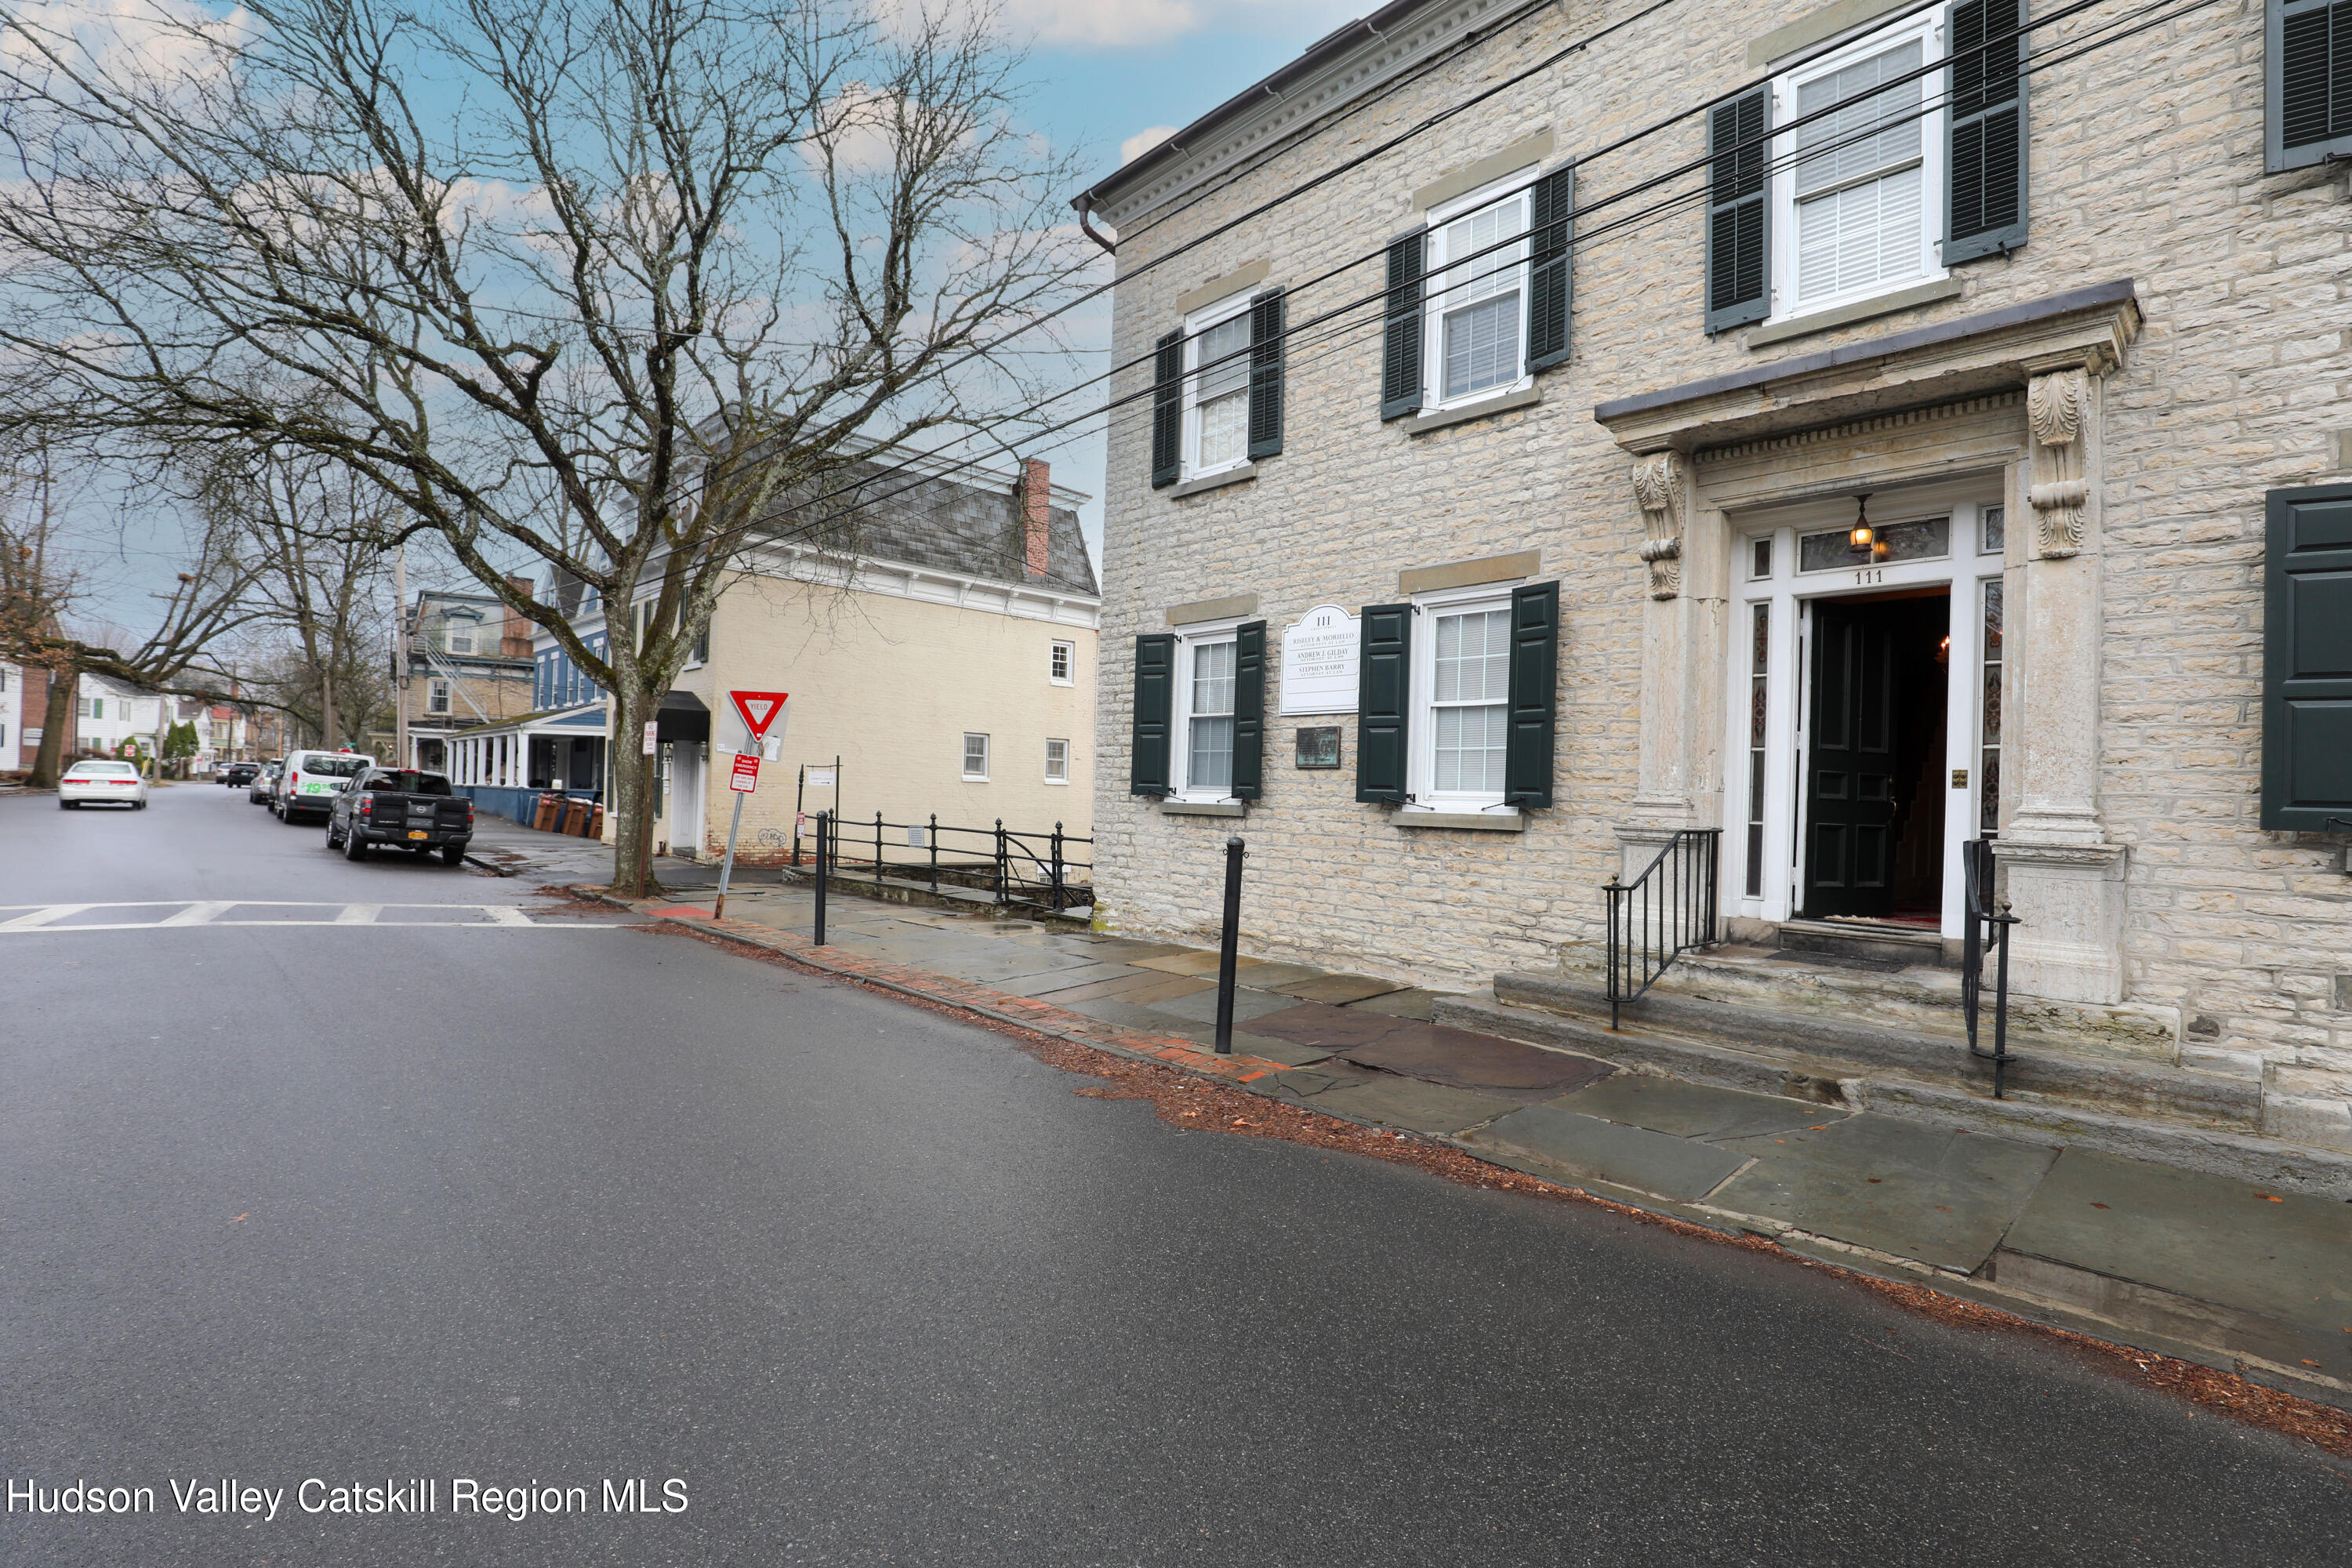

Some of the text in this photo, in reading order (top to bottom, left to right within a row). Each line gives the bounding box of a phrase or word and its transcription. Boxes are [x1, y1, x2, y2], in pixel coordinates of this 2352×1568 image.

[1855, 569, 1882, 585] 111
[1317, 615, 1330, 626] 111
[1323, 633, 1355, 641] MORIELLO
[1298, 651, 1320, 659] ANDREW
